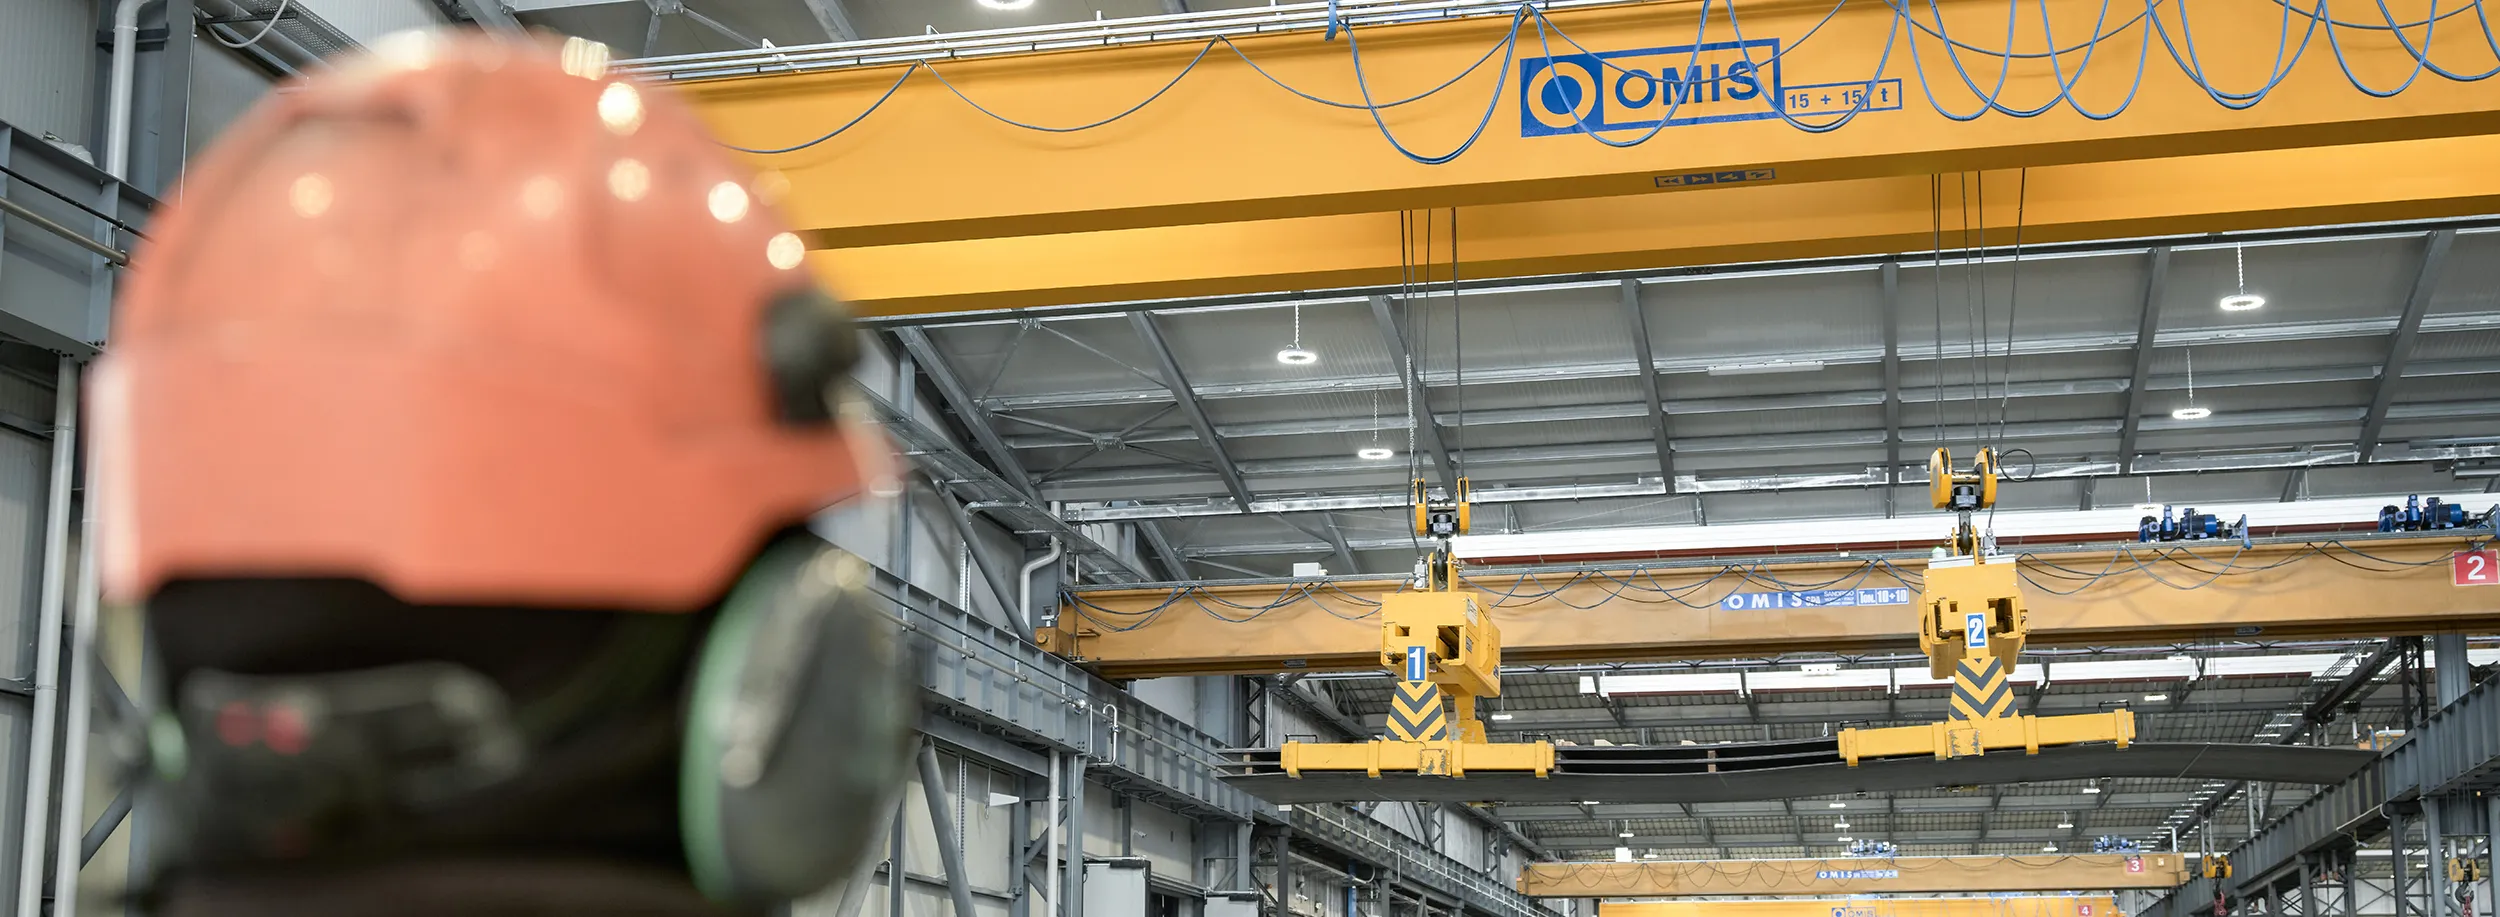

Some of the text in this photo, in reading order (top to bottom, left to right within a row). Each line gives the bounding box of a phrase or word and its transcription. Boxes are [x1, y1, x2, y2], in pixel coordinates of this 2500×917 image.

[1614, 61, 1761, 109] OMIS
[1789, 88, 1889, 109] 15 + 15 t
[2467, 555, 2486, 580] 2
[1729, 593, 1802, 609] OMIS
[1877, 590, 1907, 603] 10+10
[1969, 617, 1984, 644] 2
[1409, 647, 1421, 679] 1
[2131, 860, 2140, 872] 3
[2081, 906, 2090, 916] 4
